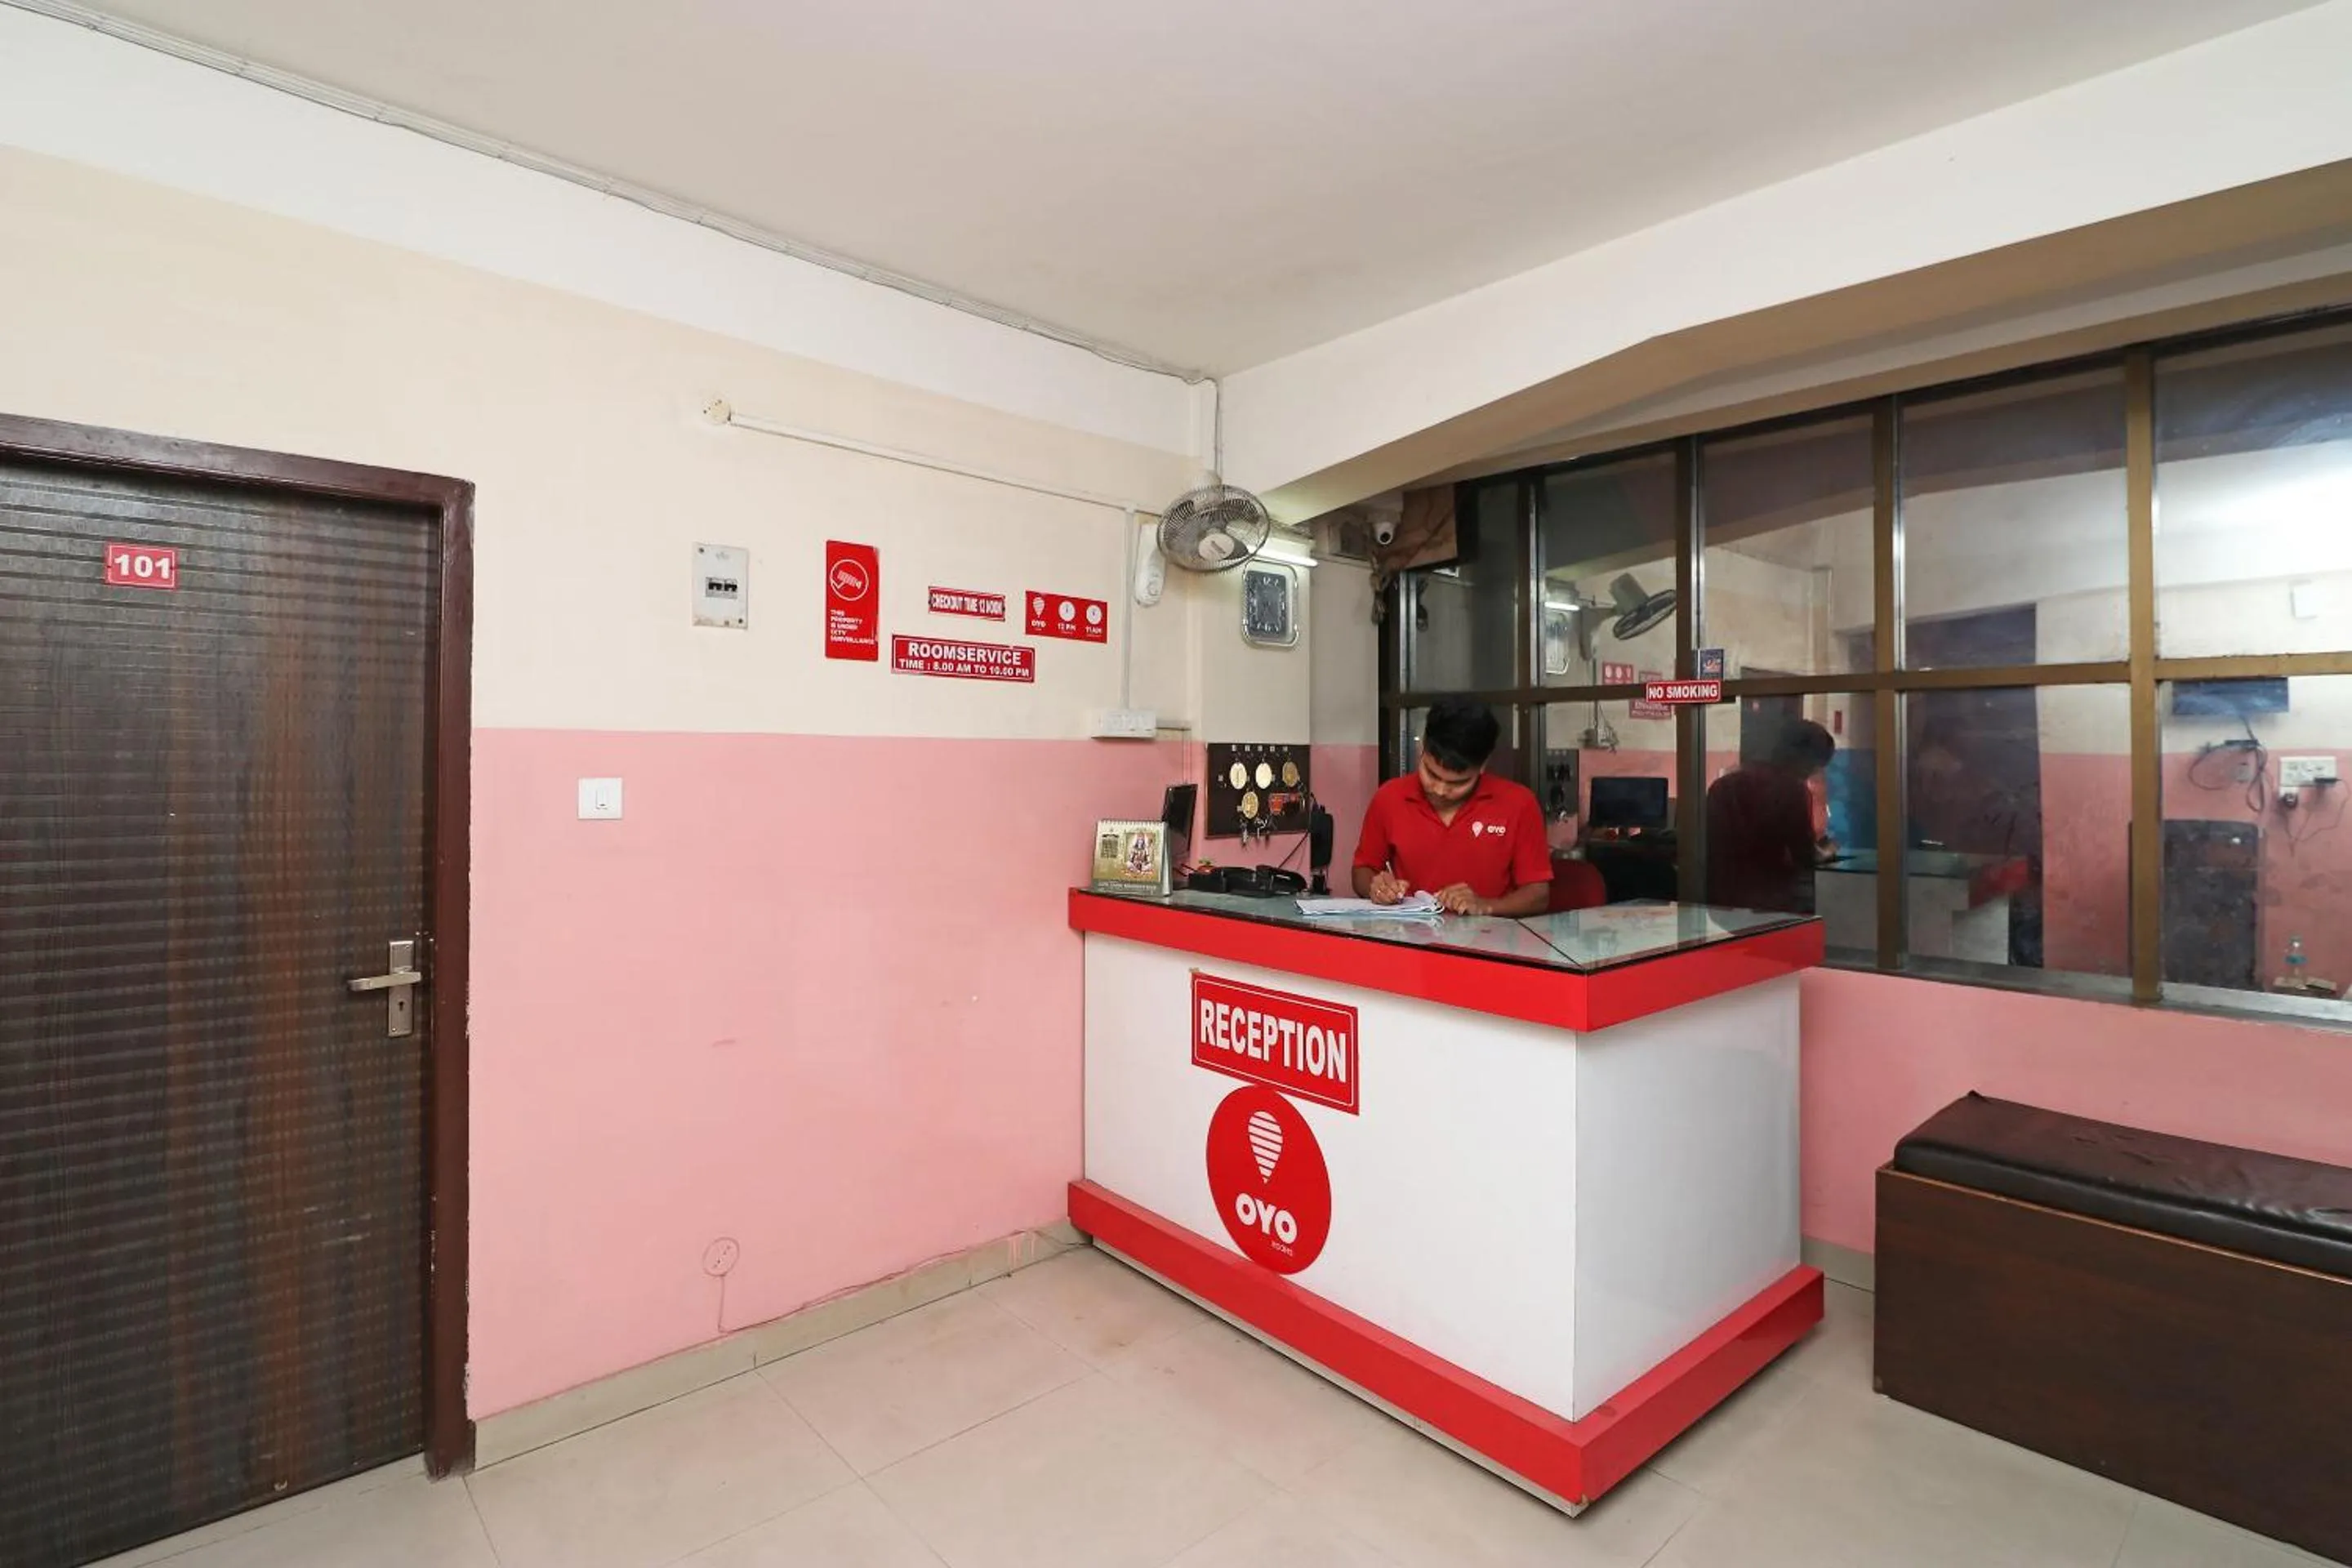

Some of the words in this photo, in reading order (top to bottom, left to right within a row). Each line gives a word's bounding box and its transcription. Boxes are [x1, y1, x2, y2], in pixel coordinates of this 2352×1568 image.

[114, 555, 170, 580] 101
[1031, 620, 1046, 628] OYO
[908, 642, 1021, 665] ROOMSERVICE
[898, 659, 924, 670] TIME
[933, 662, 954, 672] 8.00
[956, 663, 971, 674] AM
[974, 665, 987, 674] TO
[1016, 668, 1029, 677] PM
[1649, 687, 1664, 699] NO
[1666, 684, 1717, 699] SMOKING
[1200, 998, 1347, 1083] RECEPTION
[1236, 1192, 1297, 1244] OYO
